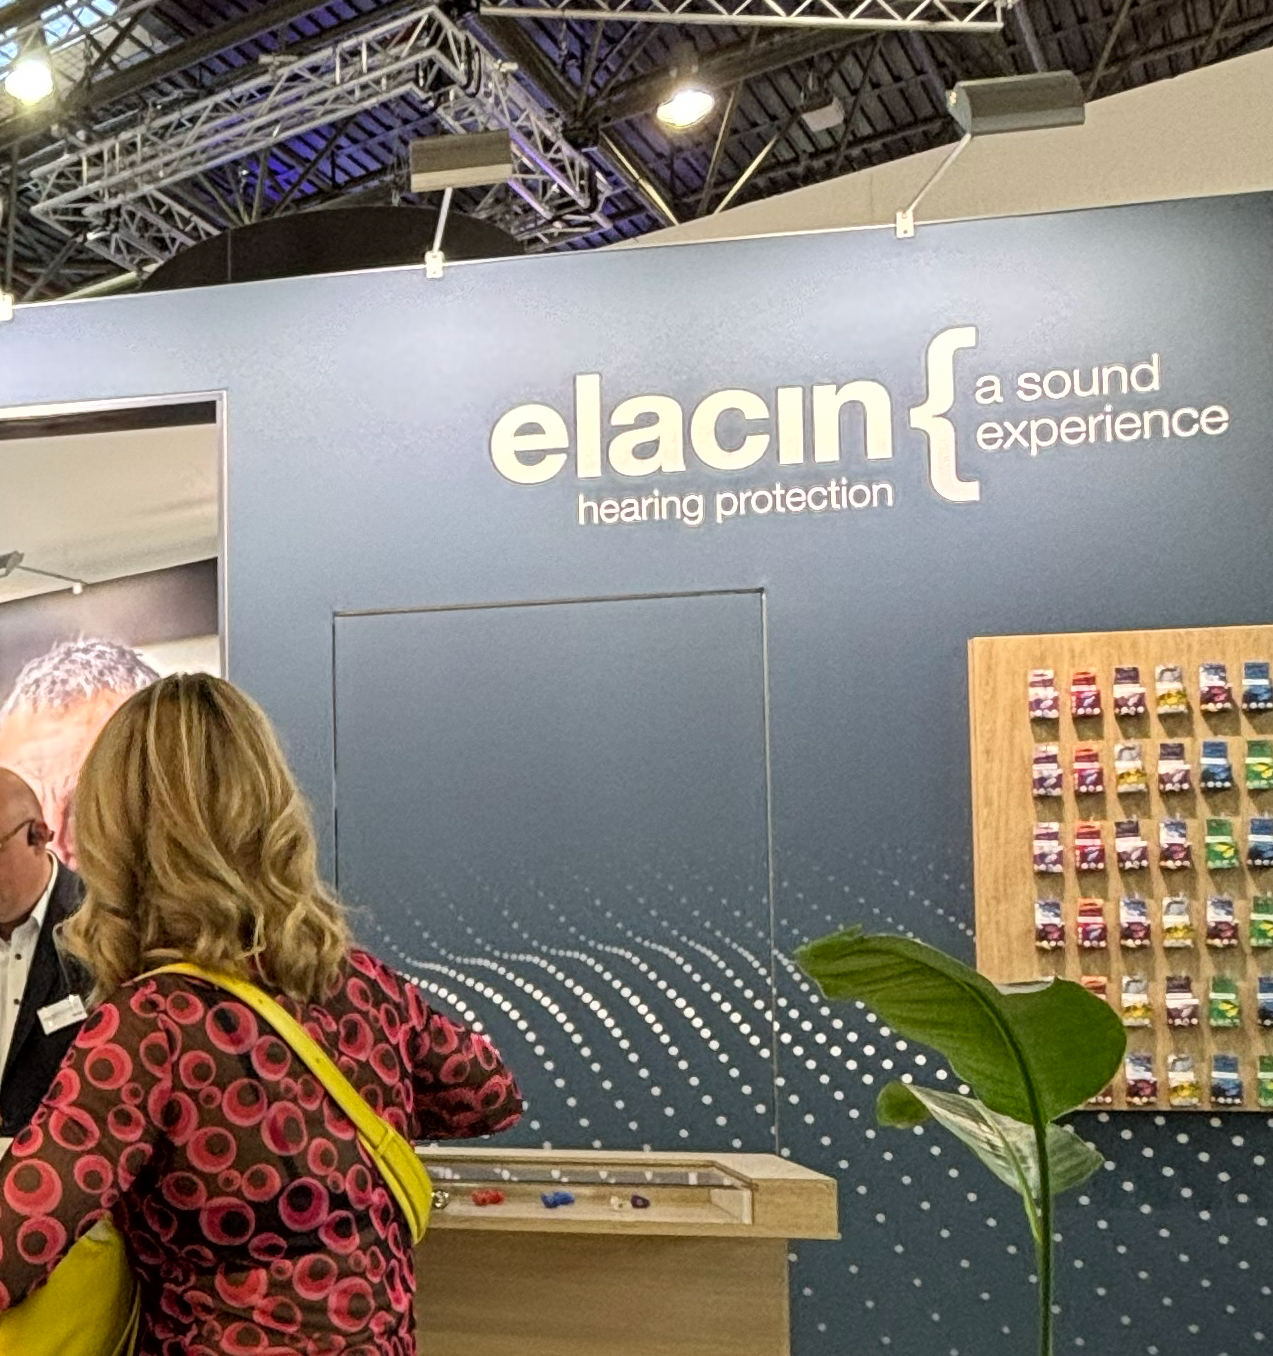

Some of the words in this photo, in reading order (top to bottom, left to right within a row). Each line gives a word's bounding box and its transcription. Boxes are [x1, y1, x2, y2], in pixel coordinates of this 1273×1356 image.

[975, 374, 1003, 404] a
[1016, 353, 1160, 401] sound
[976, 403, 1229, 457] experience
[579, 487, 704, 527] hearing
[716, 477, 894, 524] protection
